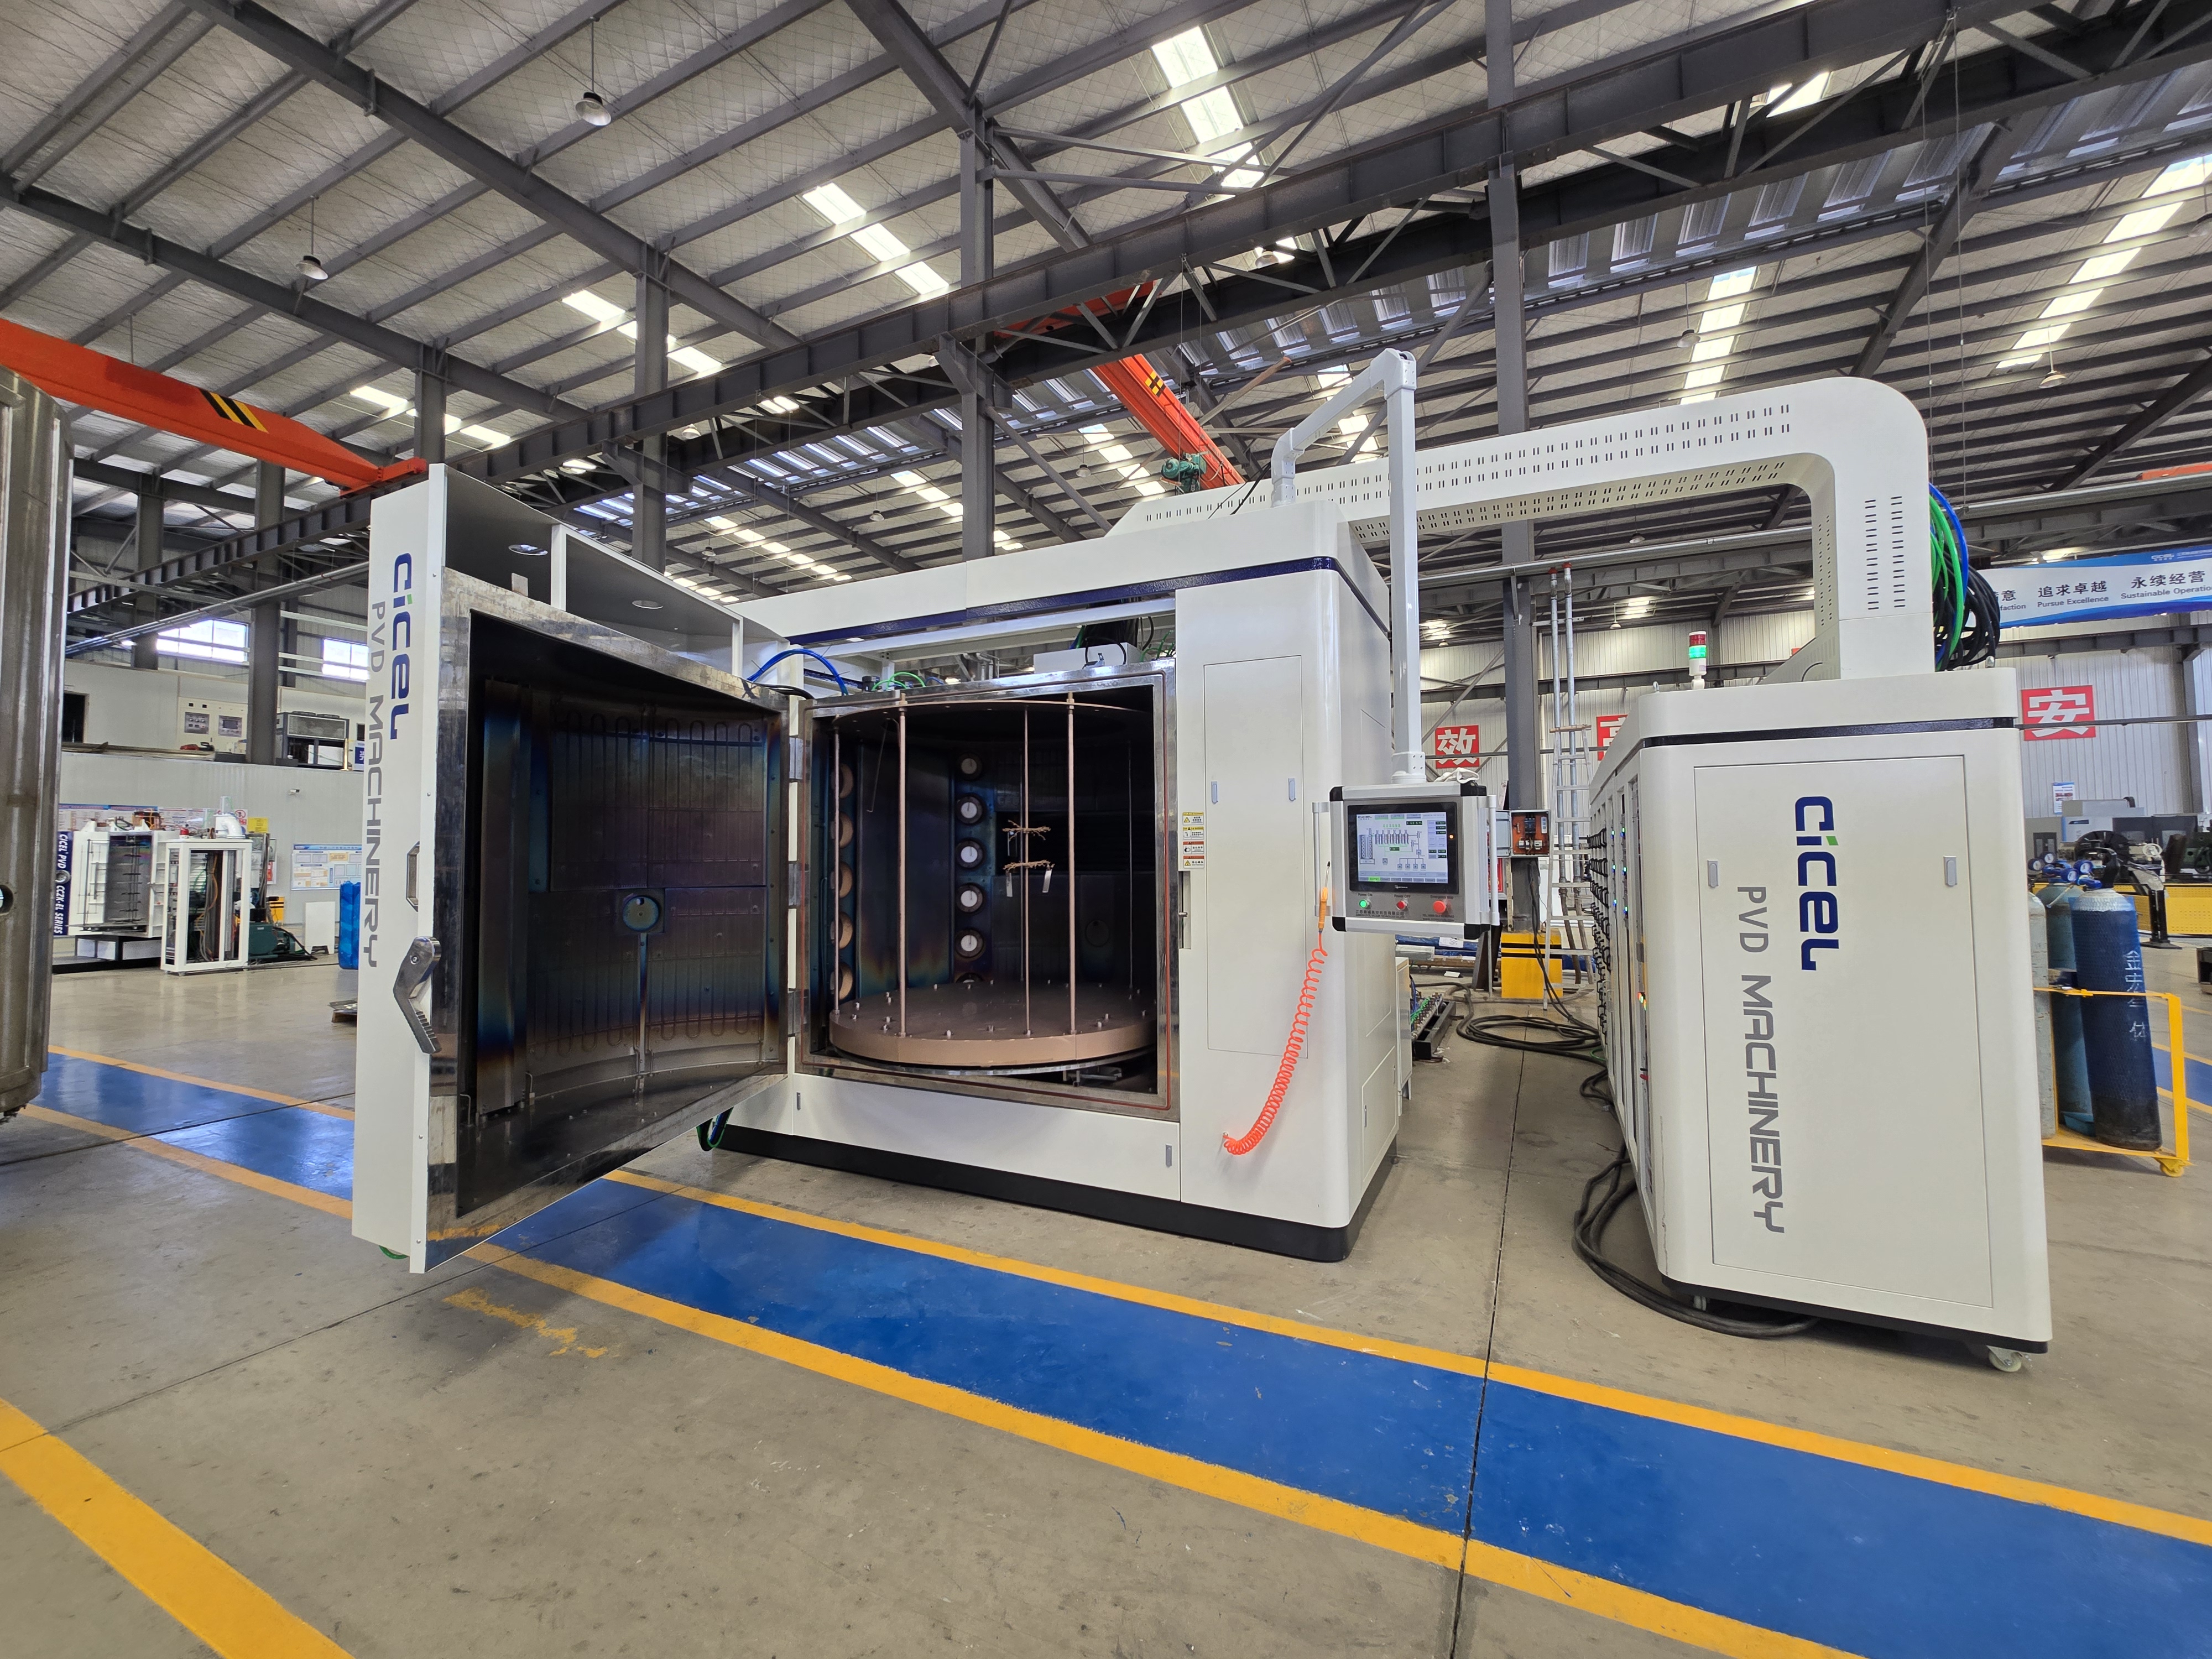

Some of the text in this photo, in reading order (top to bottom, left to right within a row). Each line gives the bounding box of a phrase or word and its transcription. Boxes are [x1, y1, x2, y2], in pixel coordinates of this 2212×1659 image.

[2038, 581, 2107, 598] 追求卓越
[2131, 571, 2205, 589] 永续经营
[2037, 595, 2109, 608] Pursue Excellence
[2121, 585, 2212, 599] Sustainable Operatio
[2027, 690, 2090, 737] 安
[1437, 728, 1477, 765] 效
[363, 601, 386, 968] PVD MACHINERY
[58, 854, 67, 869] PVD
[54, 912, 64, 934] SERIES
[1737, 885, 1785, 1234] PVD MACHINERY
